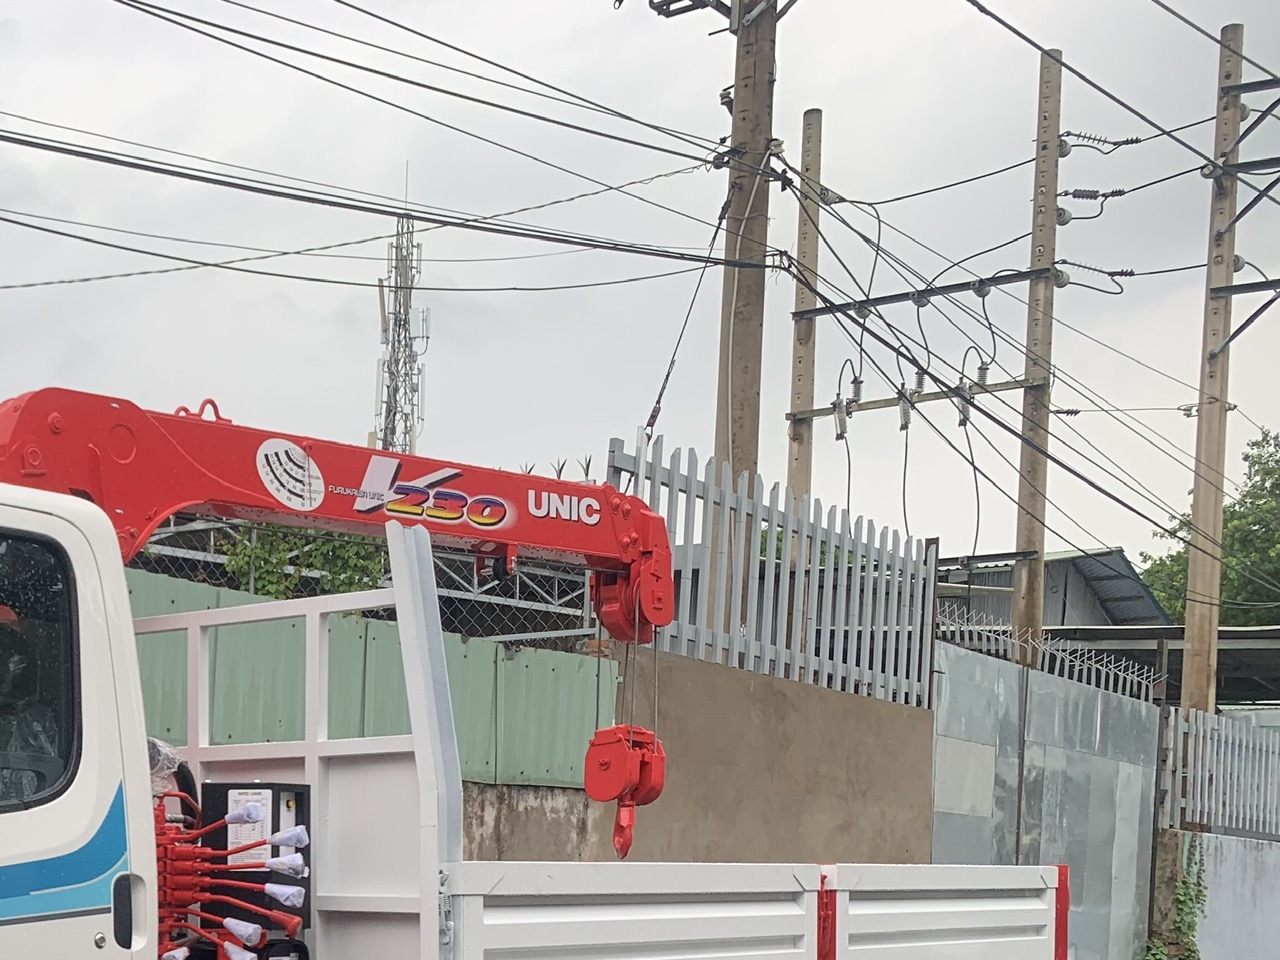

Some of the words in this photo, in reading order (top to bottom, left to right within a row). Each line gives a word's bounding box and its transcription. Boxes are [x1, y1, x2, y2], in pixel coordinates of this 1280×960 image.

[328, 484, 368, 499] FURUKAWA
[368, 490, 385, 502] UNIC
[528, 489, 601, 526] UNIC
